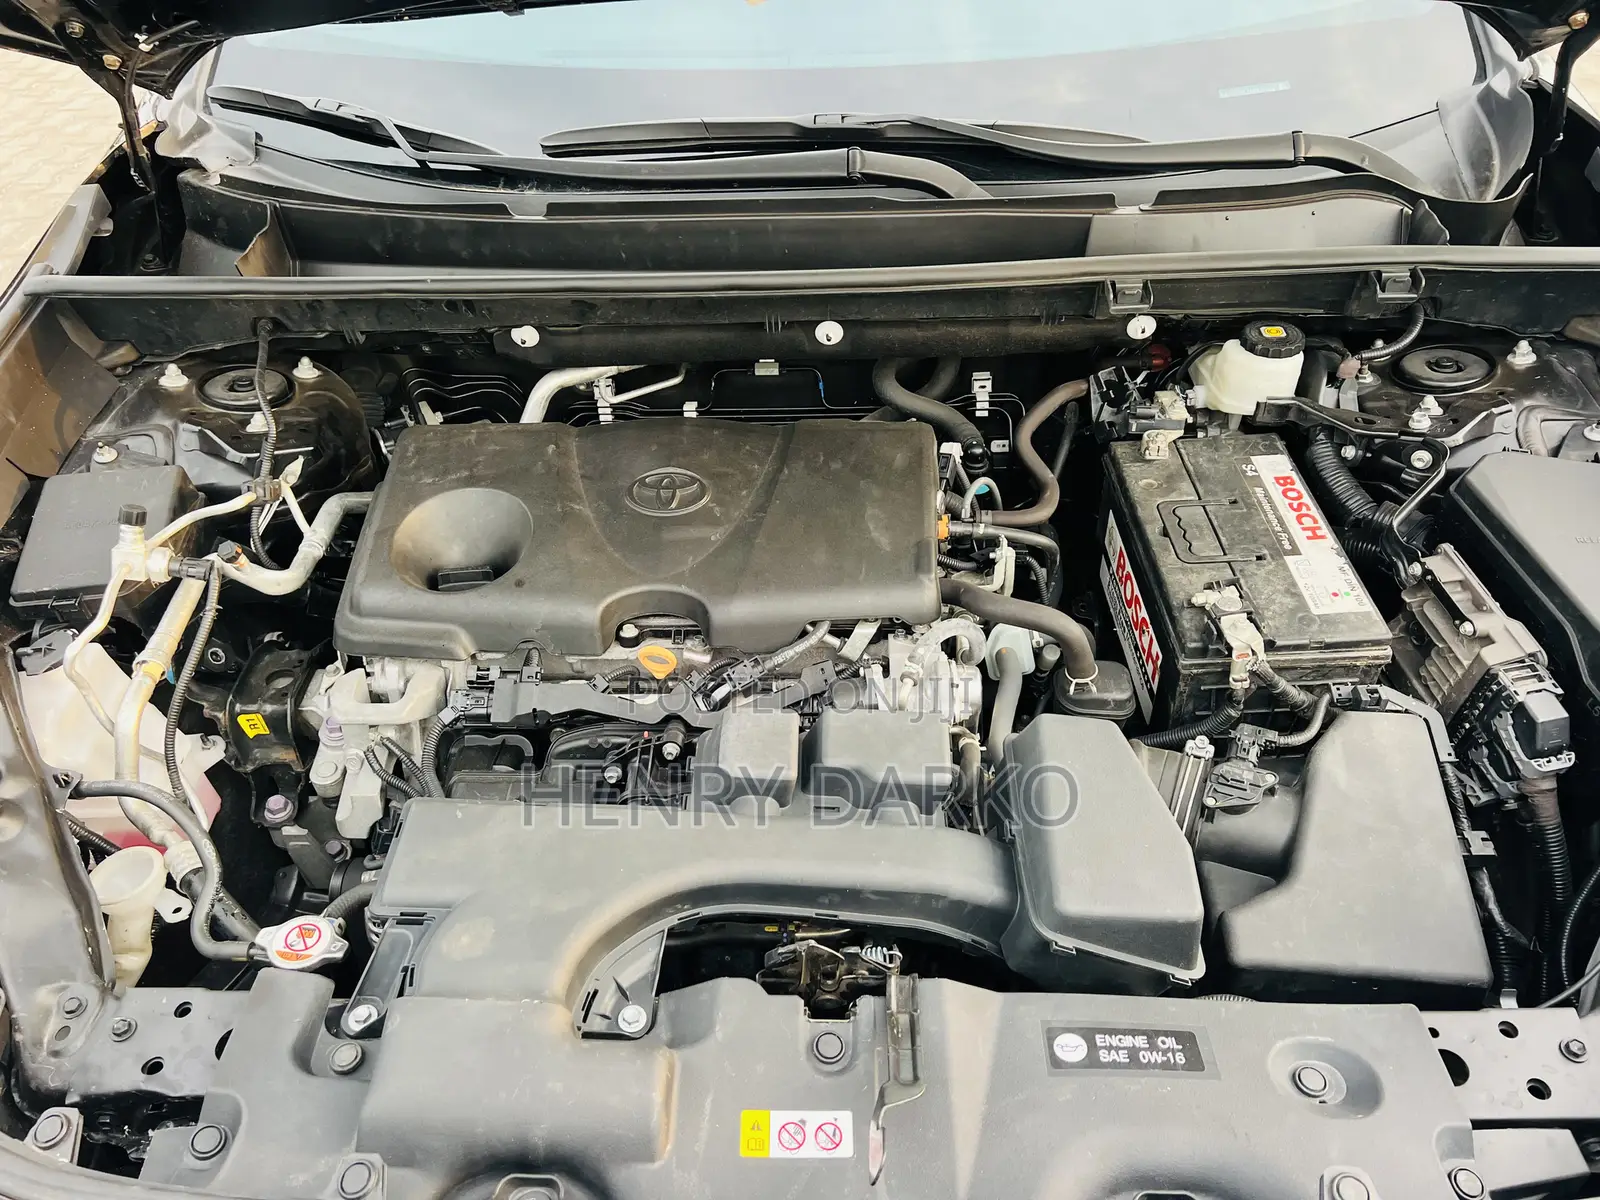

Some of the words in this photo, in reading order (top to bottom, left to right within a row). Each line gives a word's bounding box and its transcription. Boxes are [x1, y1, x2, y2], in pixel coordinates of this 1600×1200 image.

[1241, 464, 1259, 477] S4
[1253, 486, 1283, 532] Maintenance
[1277, 531, 1293, 550] Free
[1274, 475, 1328, 541] BOSCH
[1116, 546, 1160, 685] BOSCH
[1095, 1034, 1150, 1048] ENGINE
[1157, 1036, 1183, 1050] OIL
[1098, 1050, 1130, 1063] SAE
[1139, 1051, 1186, 1065] 0W-16
